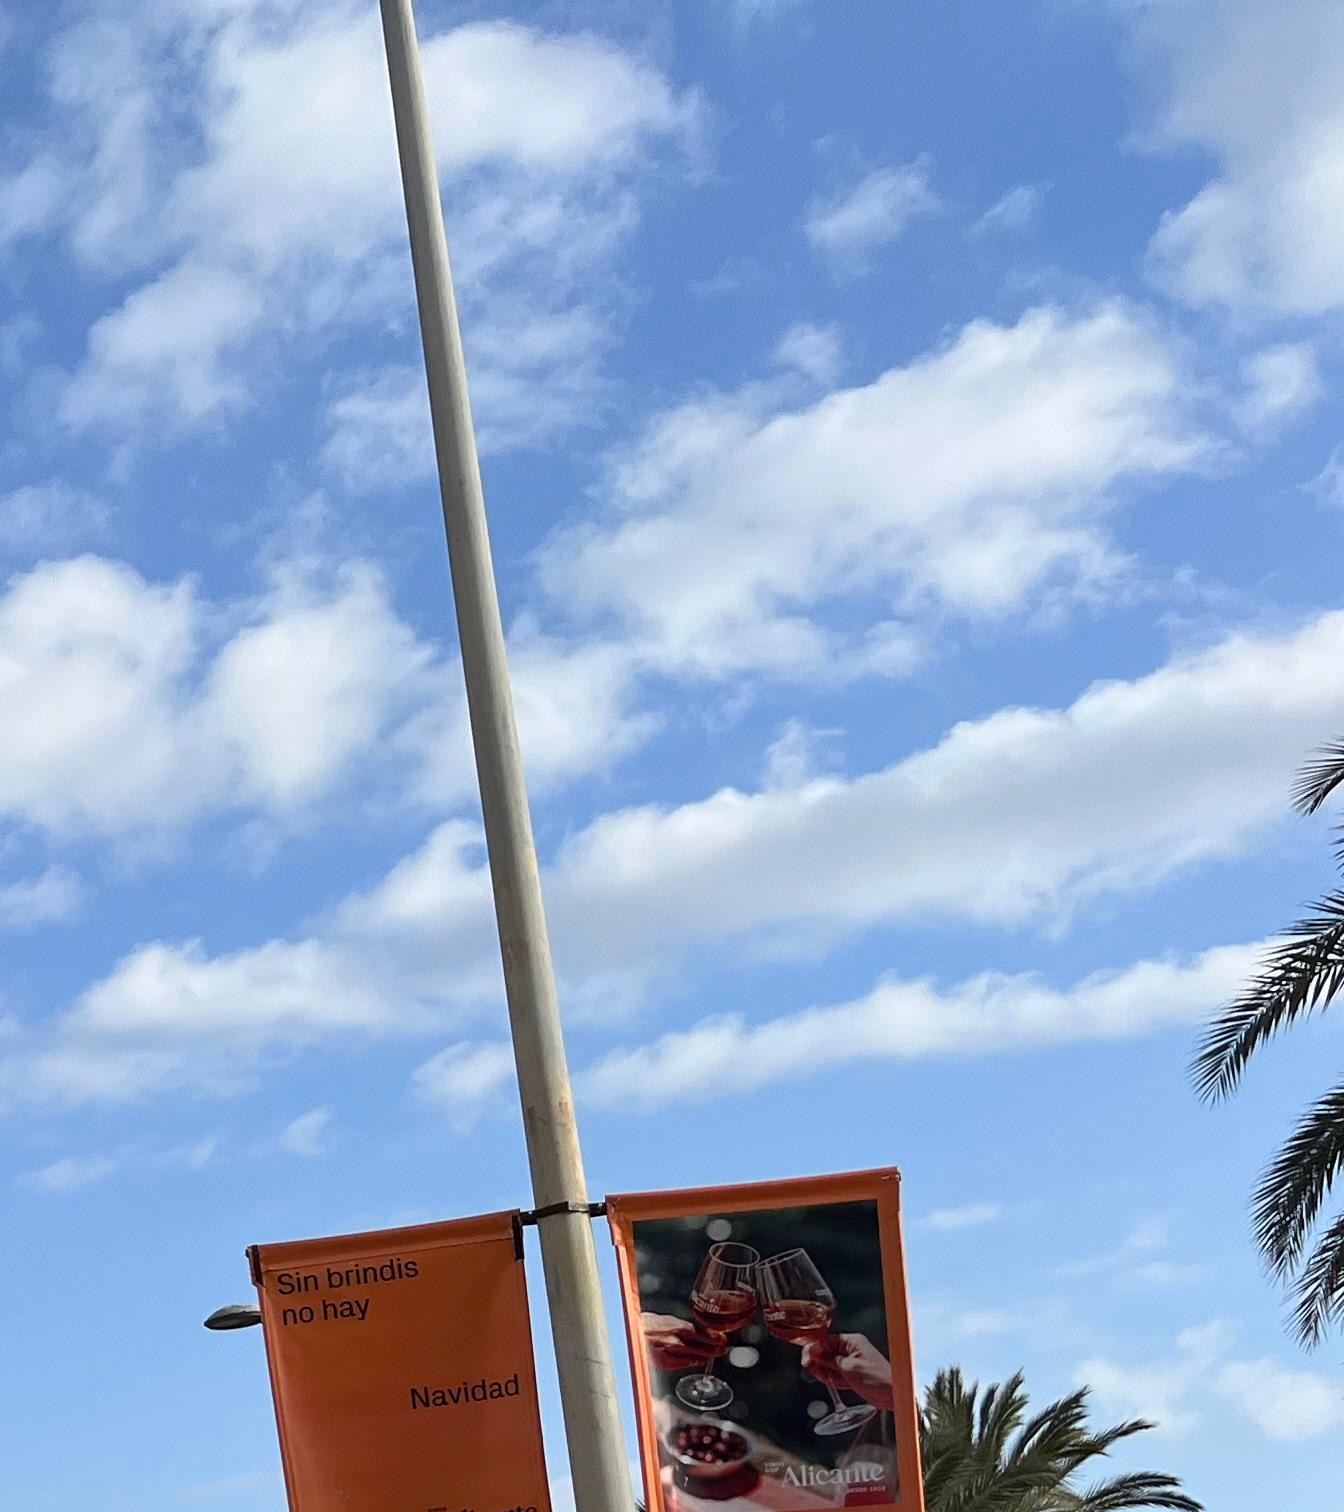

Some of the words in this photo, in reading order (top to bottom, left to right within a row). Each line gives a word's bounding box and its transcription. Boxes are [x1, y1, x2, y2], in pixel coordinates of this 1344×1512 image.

[277, 1272, 319, 1296] Sin
[327, 1257, 419, 1289] brindis
[282, 1305, 315, 1327] no
[322, 1299, 370, 1321] hay
[410, 1373, 521, 1410] Navidad
[781, 1463, 886, 1488] Alicante
